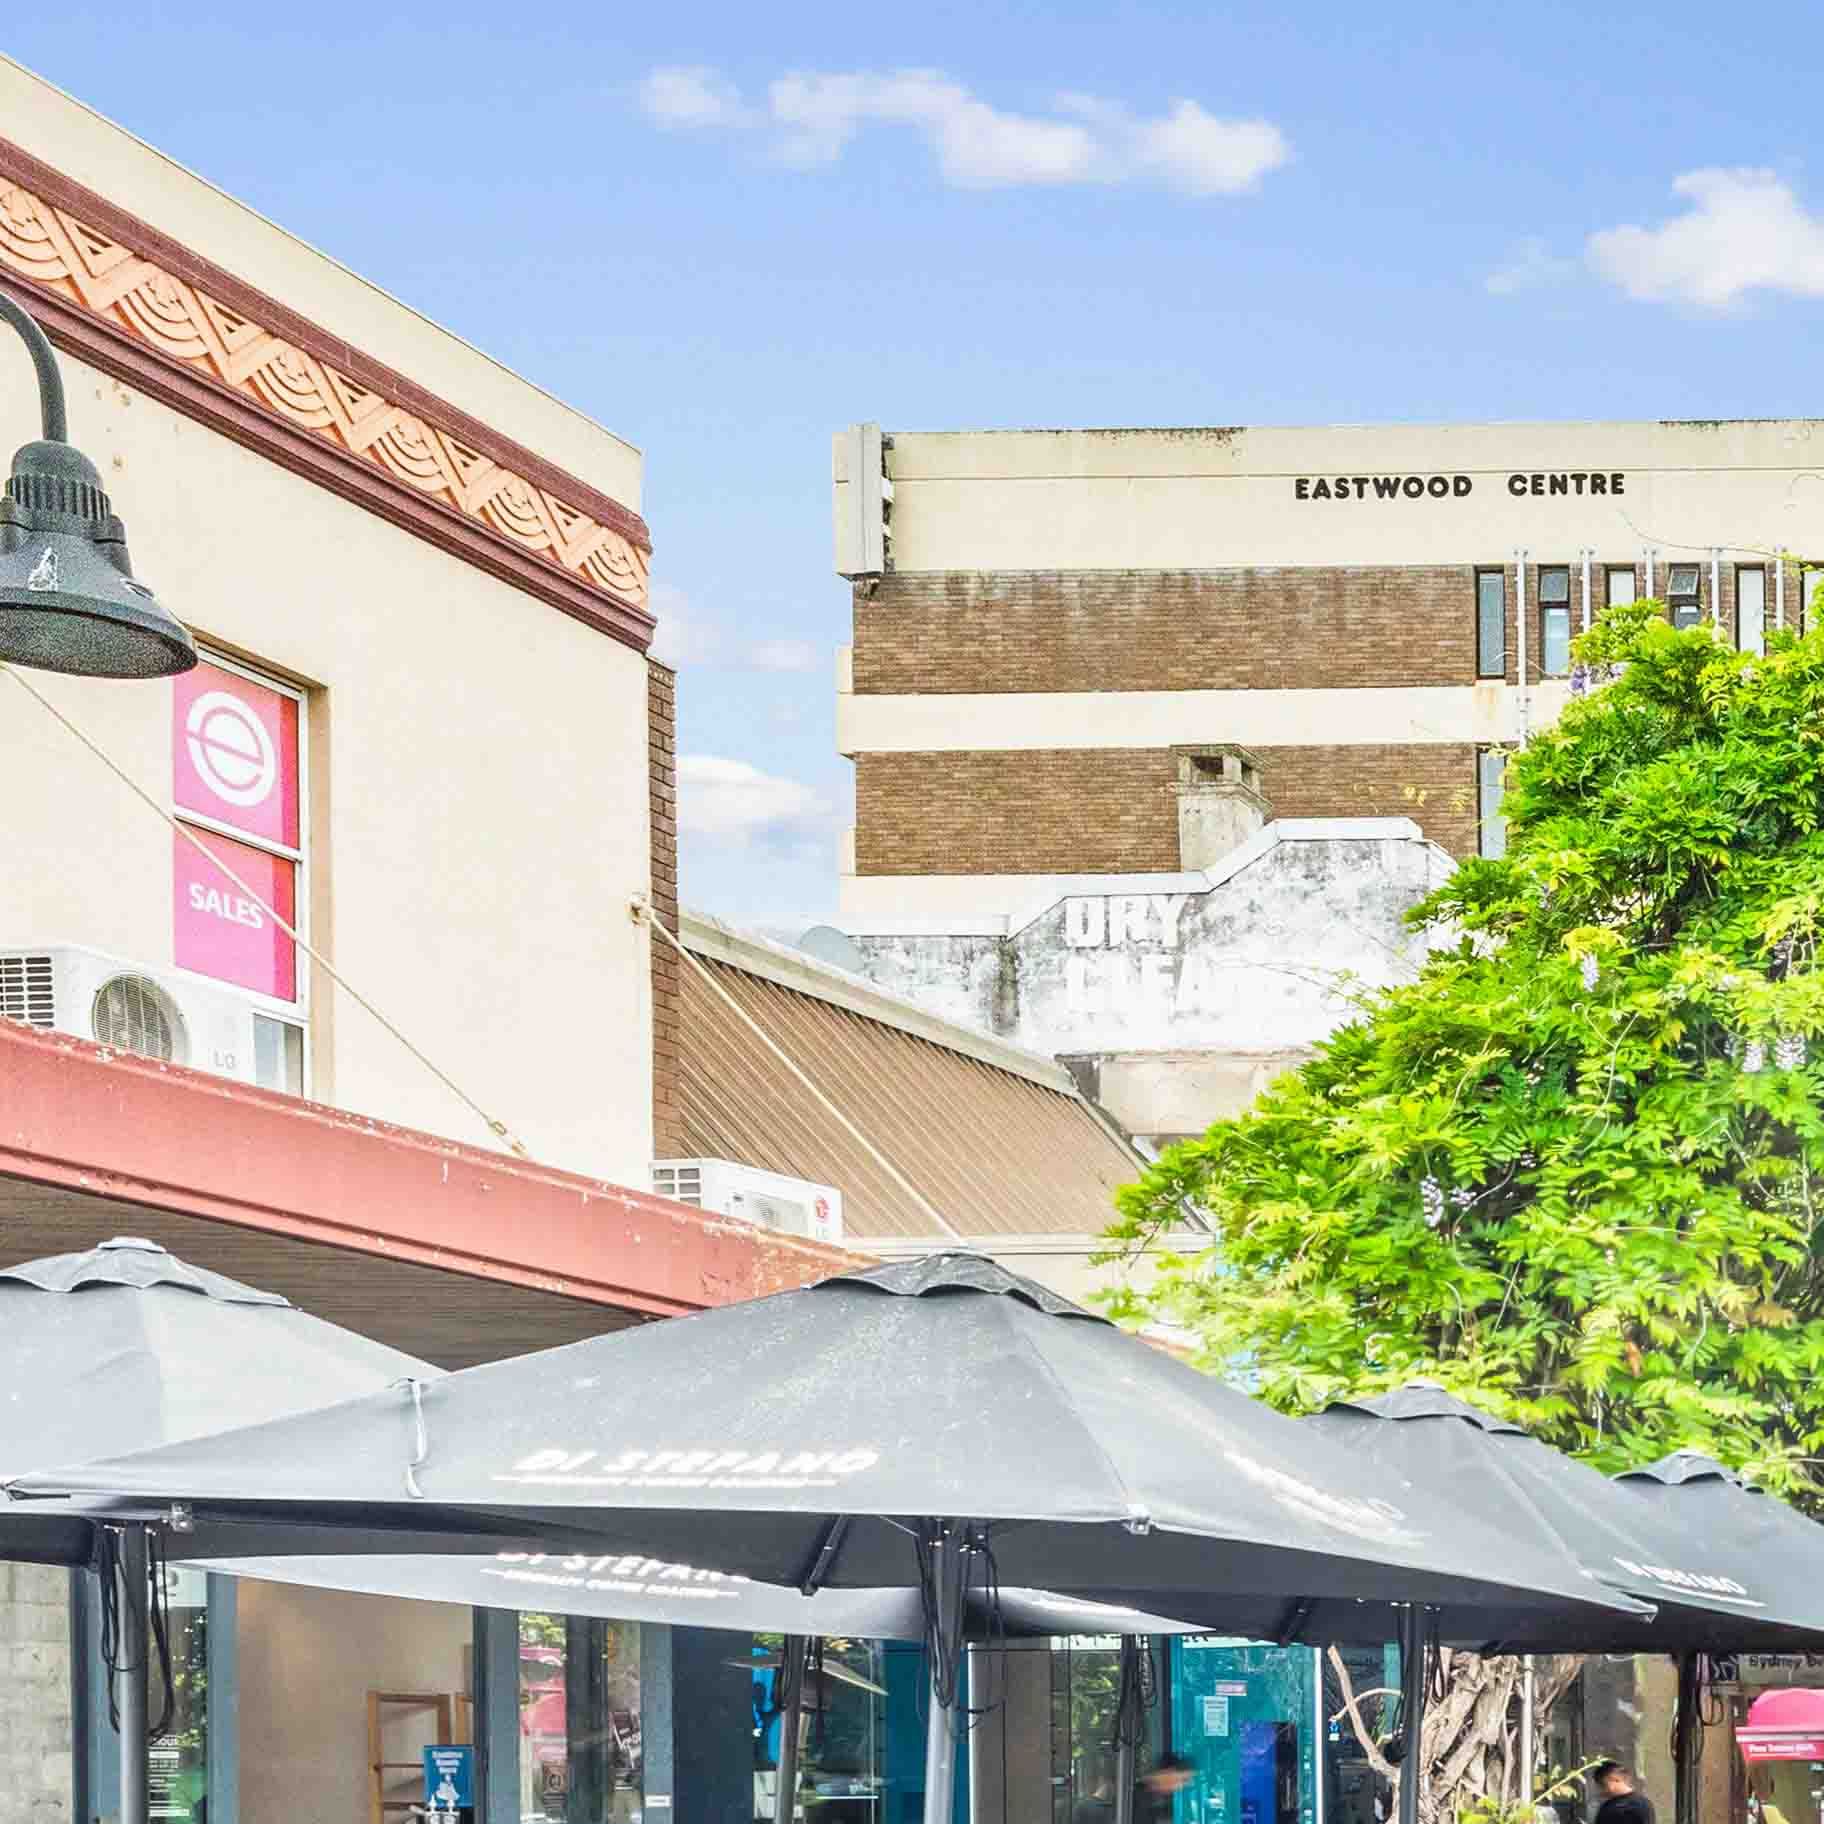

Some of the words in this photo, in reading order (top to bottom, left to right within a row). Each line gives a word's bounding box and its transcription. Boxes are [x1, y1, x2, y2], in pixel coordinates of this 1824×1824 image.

[1294, 475, 1473, 500] EASTWOOD
[1507, 472, 1625, 496] CENTRE
[188, 882, 264, 929] SALES
